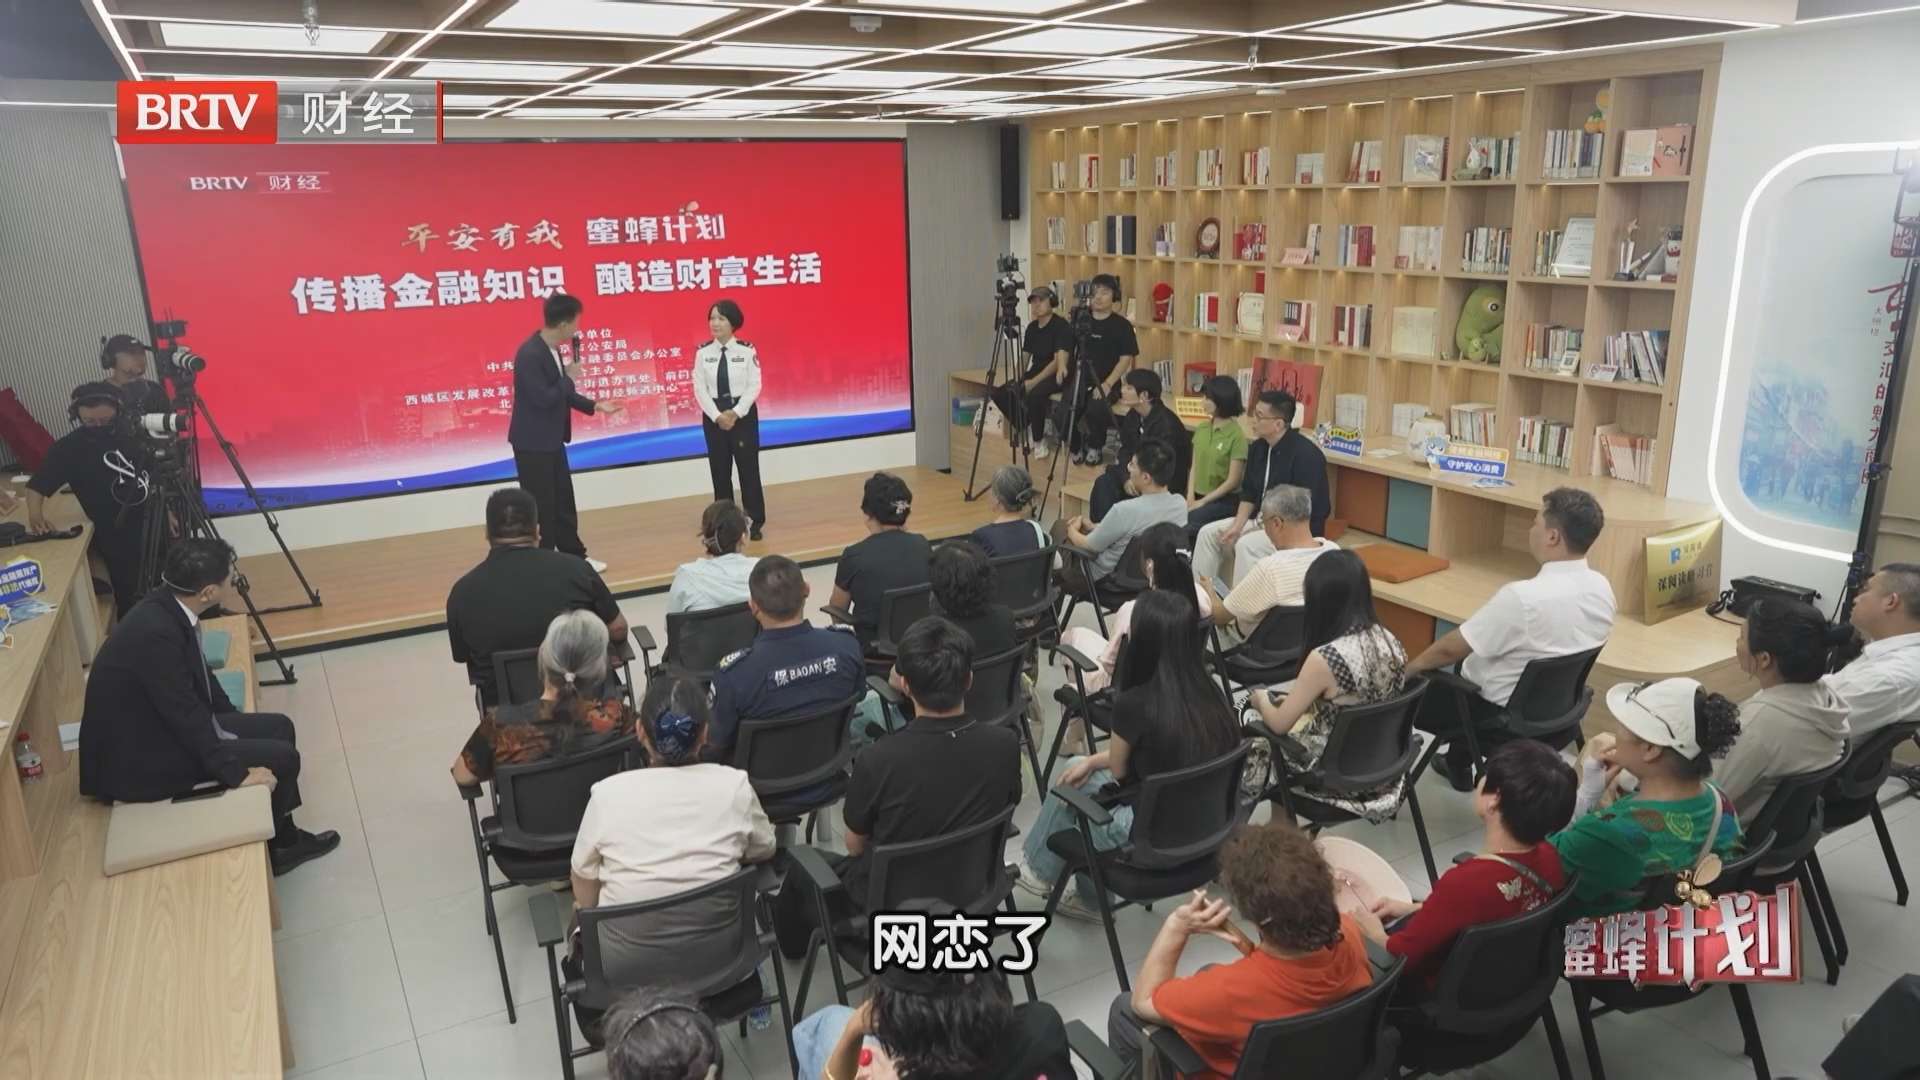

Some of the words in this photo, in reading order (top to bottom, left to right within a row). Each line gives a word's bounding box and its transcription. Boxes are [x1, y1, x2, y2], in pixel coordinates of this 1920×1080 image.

[190, 176, 248, 191] BRTV
[269, 175, 321, 191] 财经
[402, 219, 563, 253] 平安有我
[586, 213, 725, 245] 蜜蜂计划
[291, 266, 567, 314] 传播金融知识
[595, 252, 822, 295] 酿造财富生活
[1447, 459, 1500, 475] 守护安心消费
